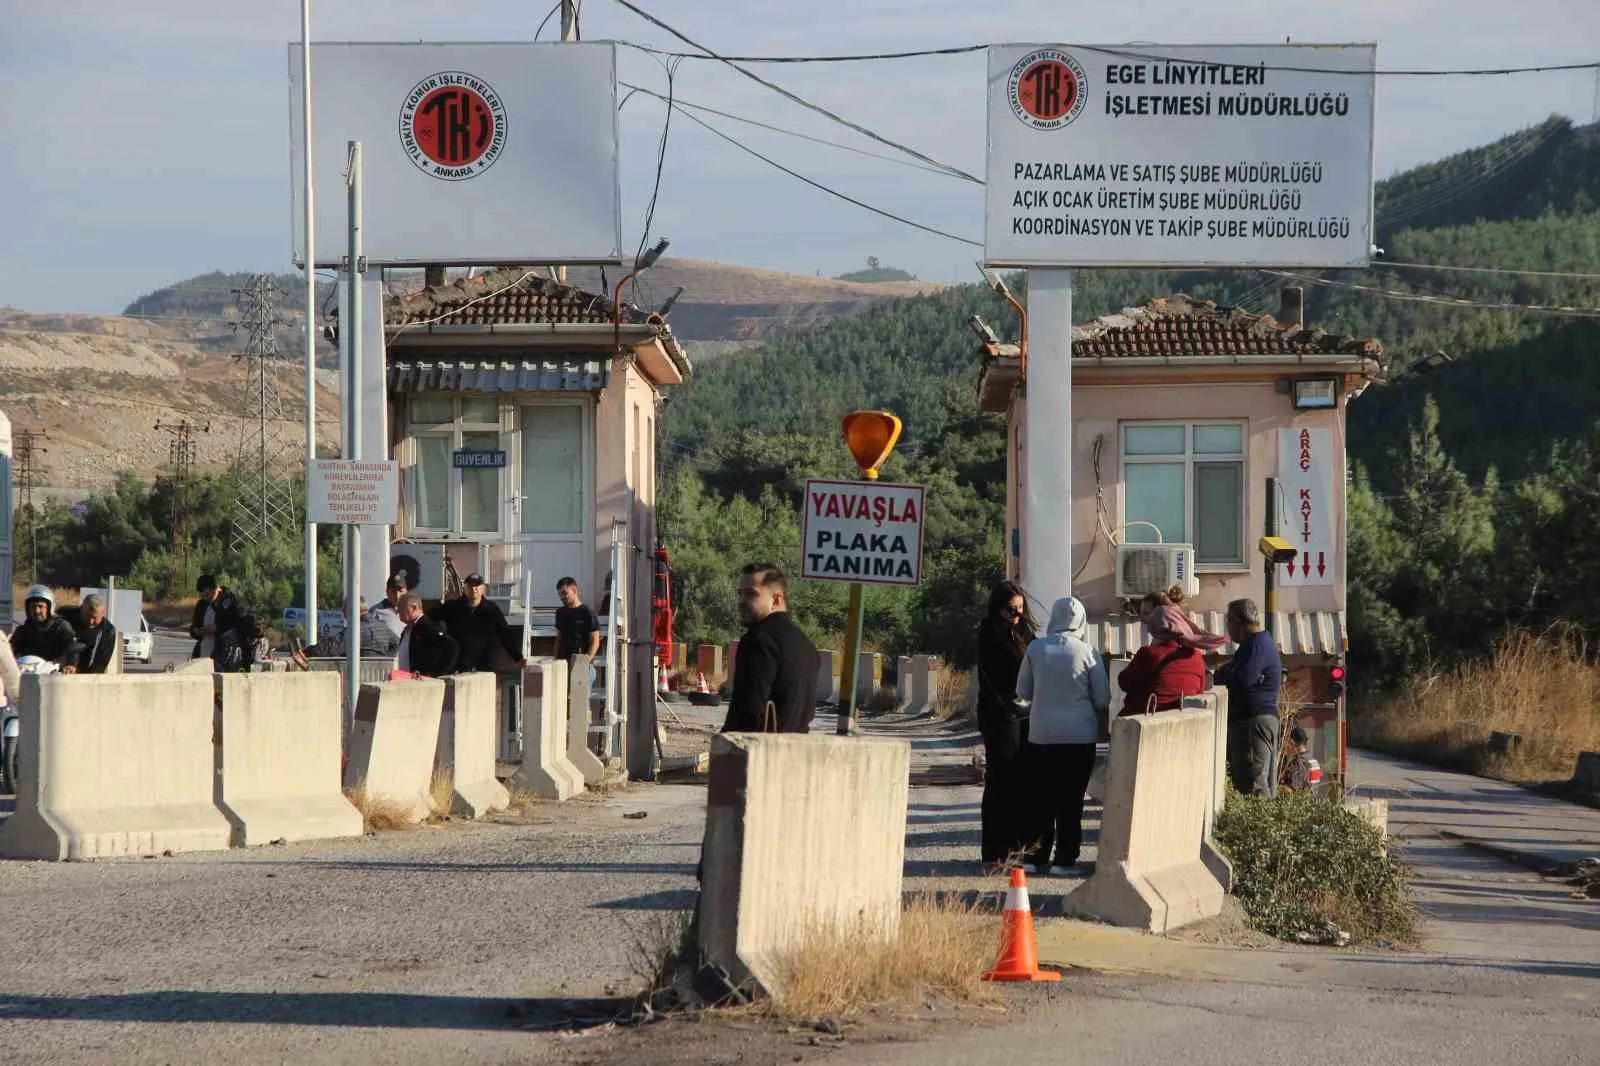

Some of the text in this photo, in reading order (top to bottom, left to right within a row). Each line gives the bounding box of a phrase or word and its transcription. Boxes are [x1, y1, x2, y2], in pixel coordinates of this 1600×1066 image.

[1106, 60, 1265, 85] EGE LİNYİTLERİ
[1105, 90, 1349, 118] İŞLETMESİ MÜDÜRLÜĞÜ
[485, 114, 504, 160] KURUMU
[433, 166, 474, 177] ANKARA
[1014, 161, 1322, 184] PAZARLAMA VE SATIŞ ŞUBE MÜDÜRLÜĞÜ
[1012, 187, 1301, 211] AÇIK OCAK ÜRETİM ŞUBE MÜDÜRLÜĞÜ
[1012, 214, 1350, 239] KOORDİNASYON VE TAKİP ŞUBE MÜDÜRLÜĞÜ
[1299, 428, 1311, 543] ARAÇ KAYIT
[812, 492, 917, 528] YAVAŞLA
[816, 530, 908, 554] PLAKA
[808, 553, 913, 578] TANIMA
